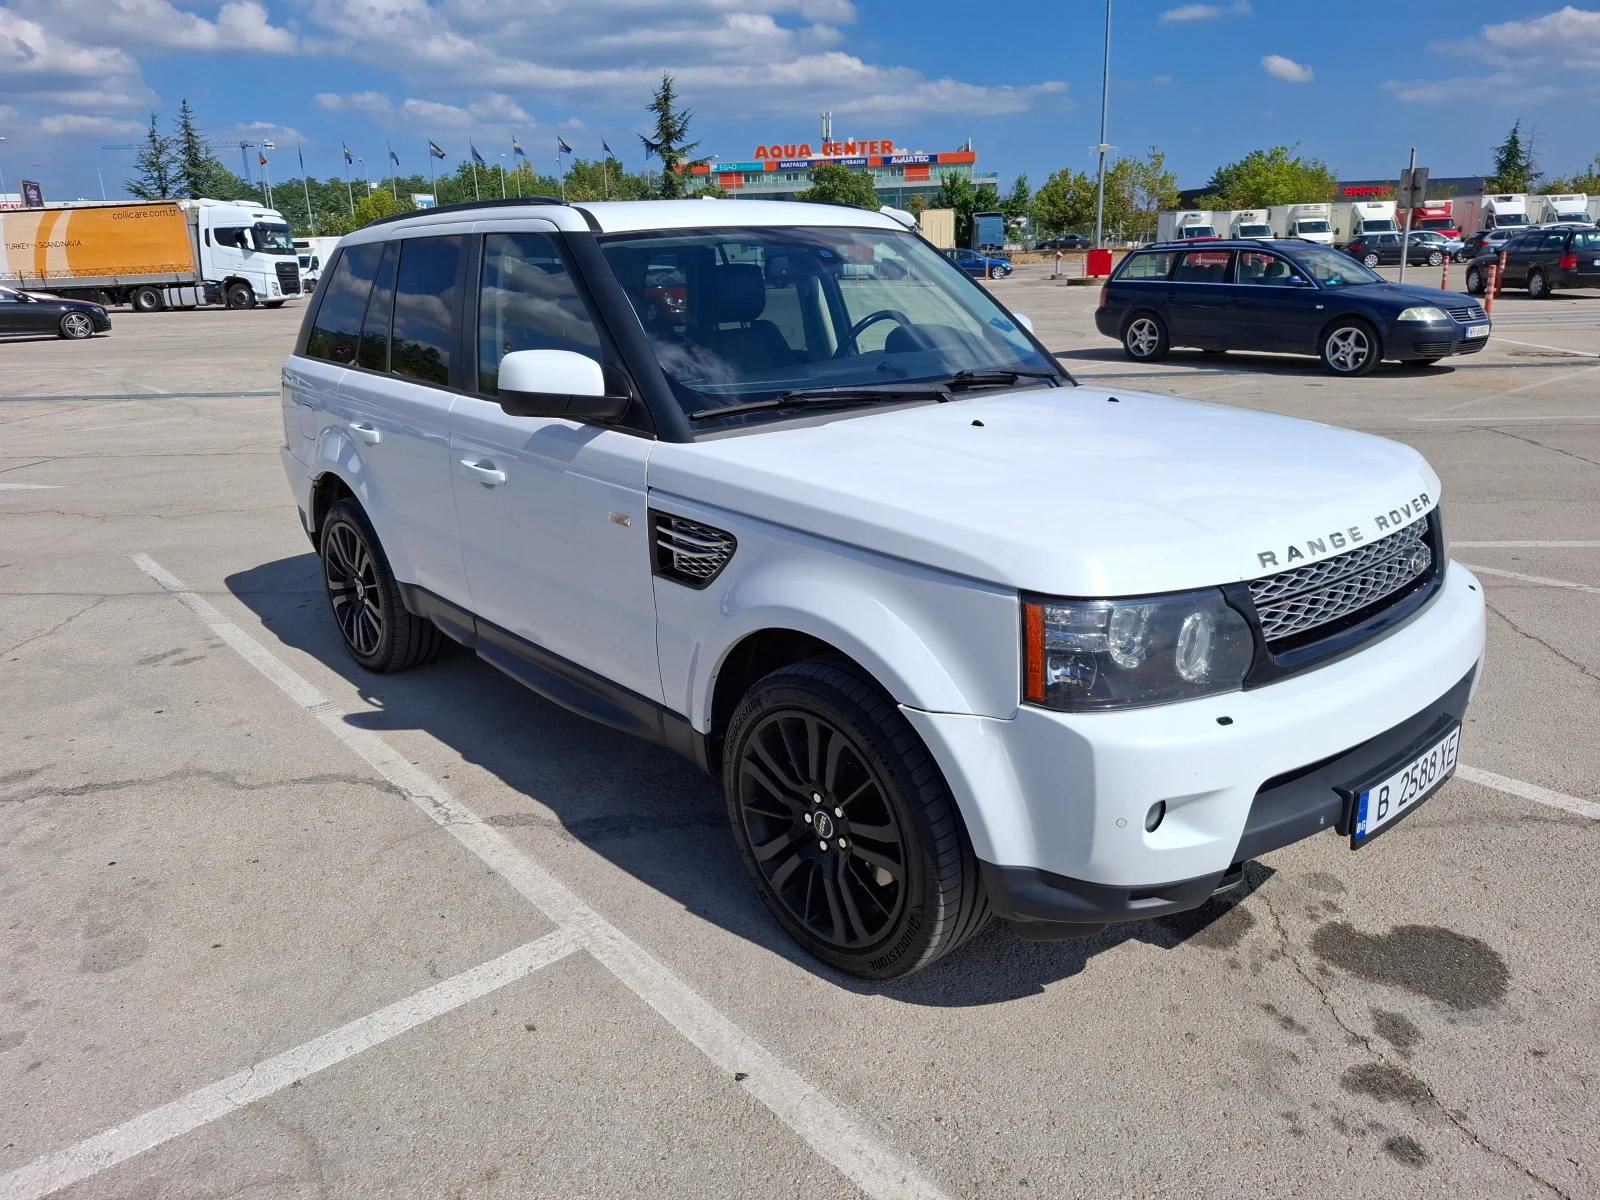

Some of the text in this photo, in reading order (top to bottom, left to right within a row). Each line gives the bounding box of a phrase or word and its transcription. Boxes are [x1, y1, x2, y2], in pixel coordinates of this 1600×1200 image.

[754, 140, 894, 159] AQUA CENTER
[891, 155, 930, 164] AQUATEC
[112, 209, 177, 220] collicare.com.tr
[5, 239, 82, 250] TURKEY SCANDINAVIA
[1257, 492, 1431, 569] RANGE ROVER
[724, 693, 764, 754] BRIDGESTONE
[851, 720, 895, 778] POTENZA
[1377, 733, 1457, 822] B 2588 XE
[1356, 819, 1366, 833] BG
[868, 915, 921, 971] BRIDGESTONE
